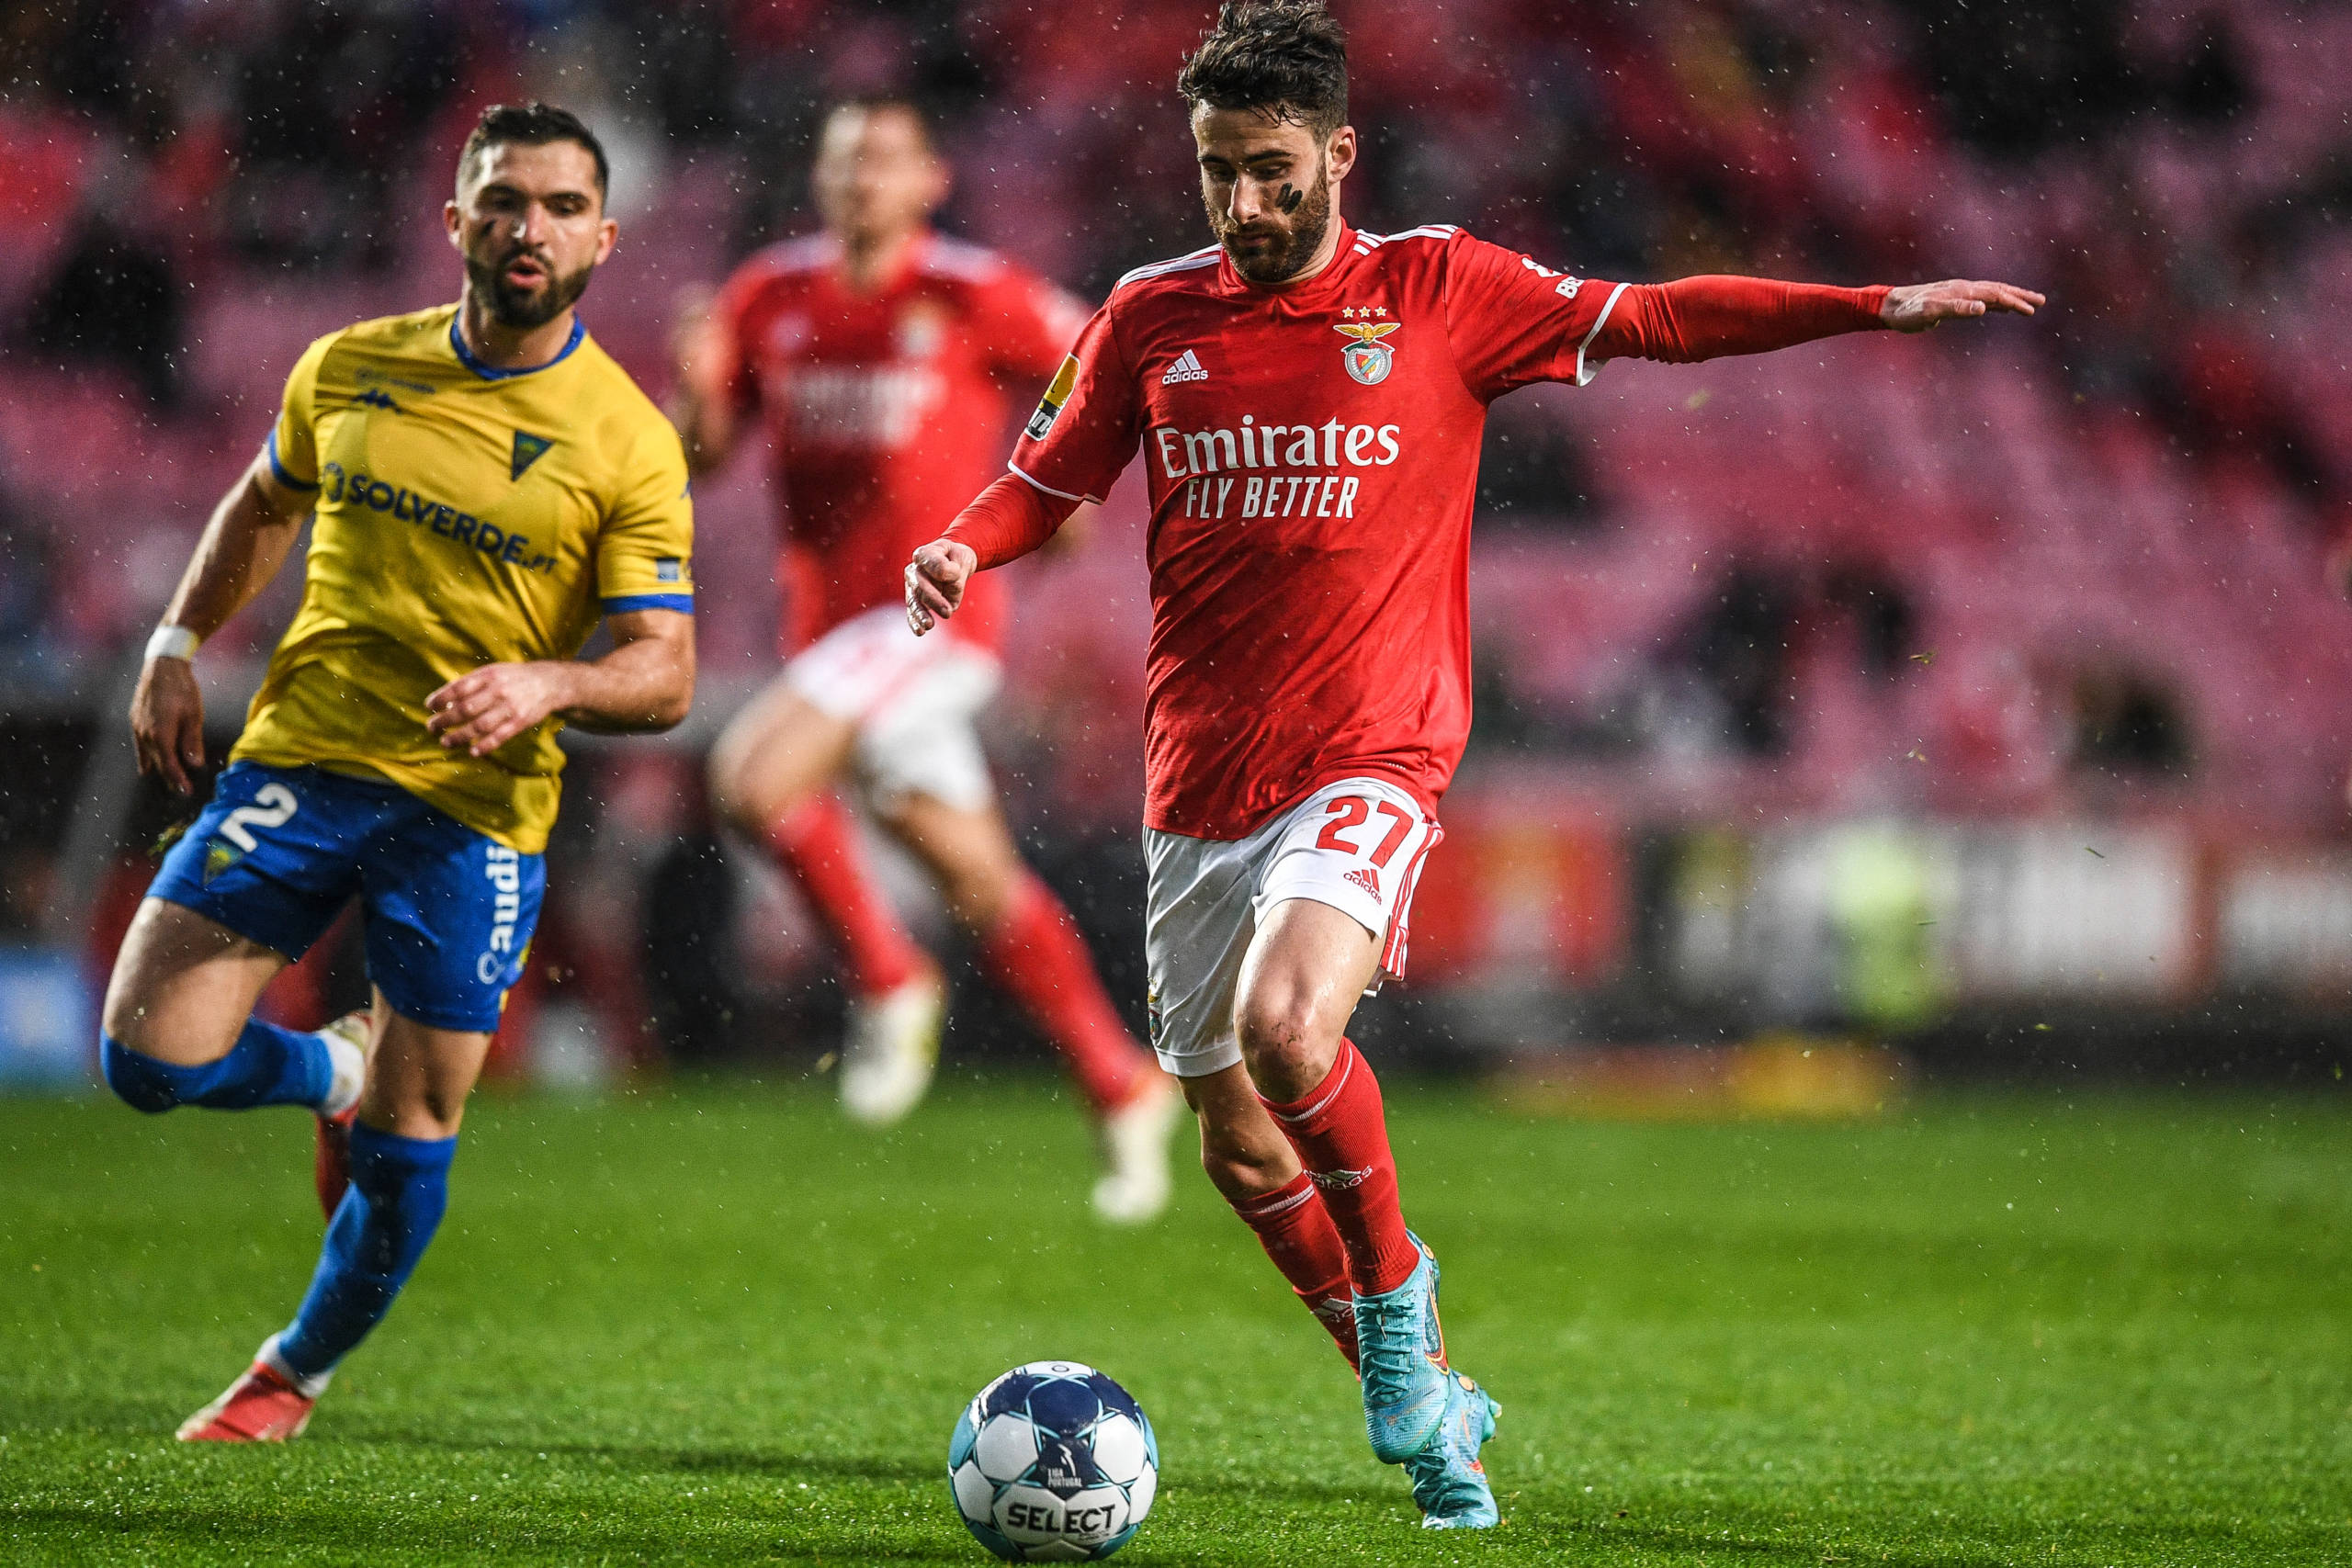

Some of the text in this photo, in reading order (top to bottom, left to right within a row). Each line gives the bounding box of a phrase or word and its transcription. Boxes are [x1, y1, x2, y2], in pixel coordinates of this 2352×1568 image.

[1161, 369, 1209, 385] adidas
[1157, 414, 1400, 479] Emirates
[1185, 476, 1360, 519] FLY BETTER
[220, 782, 298, 853] 2
[1315, 795, 1414, 869] 27
[1343, 872, 1382, 906] adidas
[1007, 1502, 1115, 1533] SELECT
